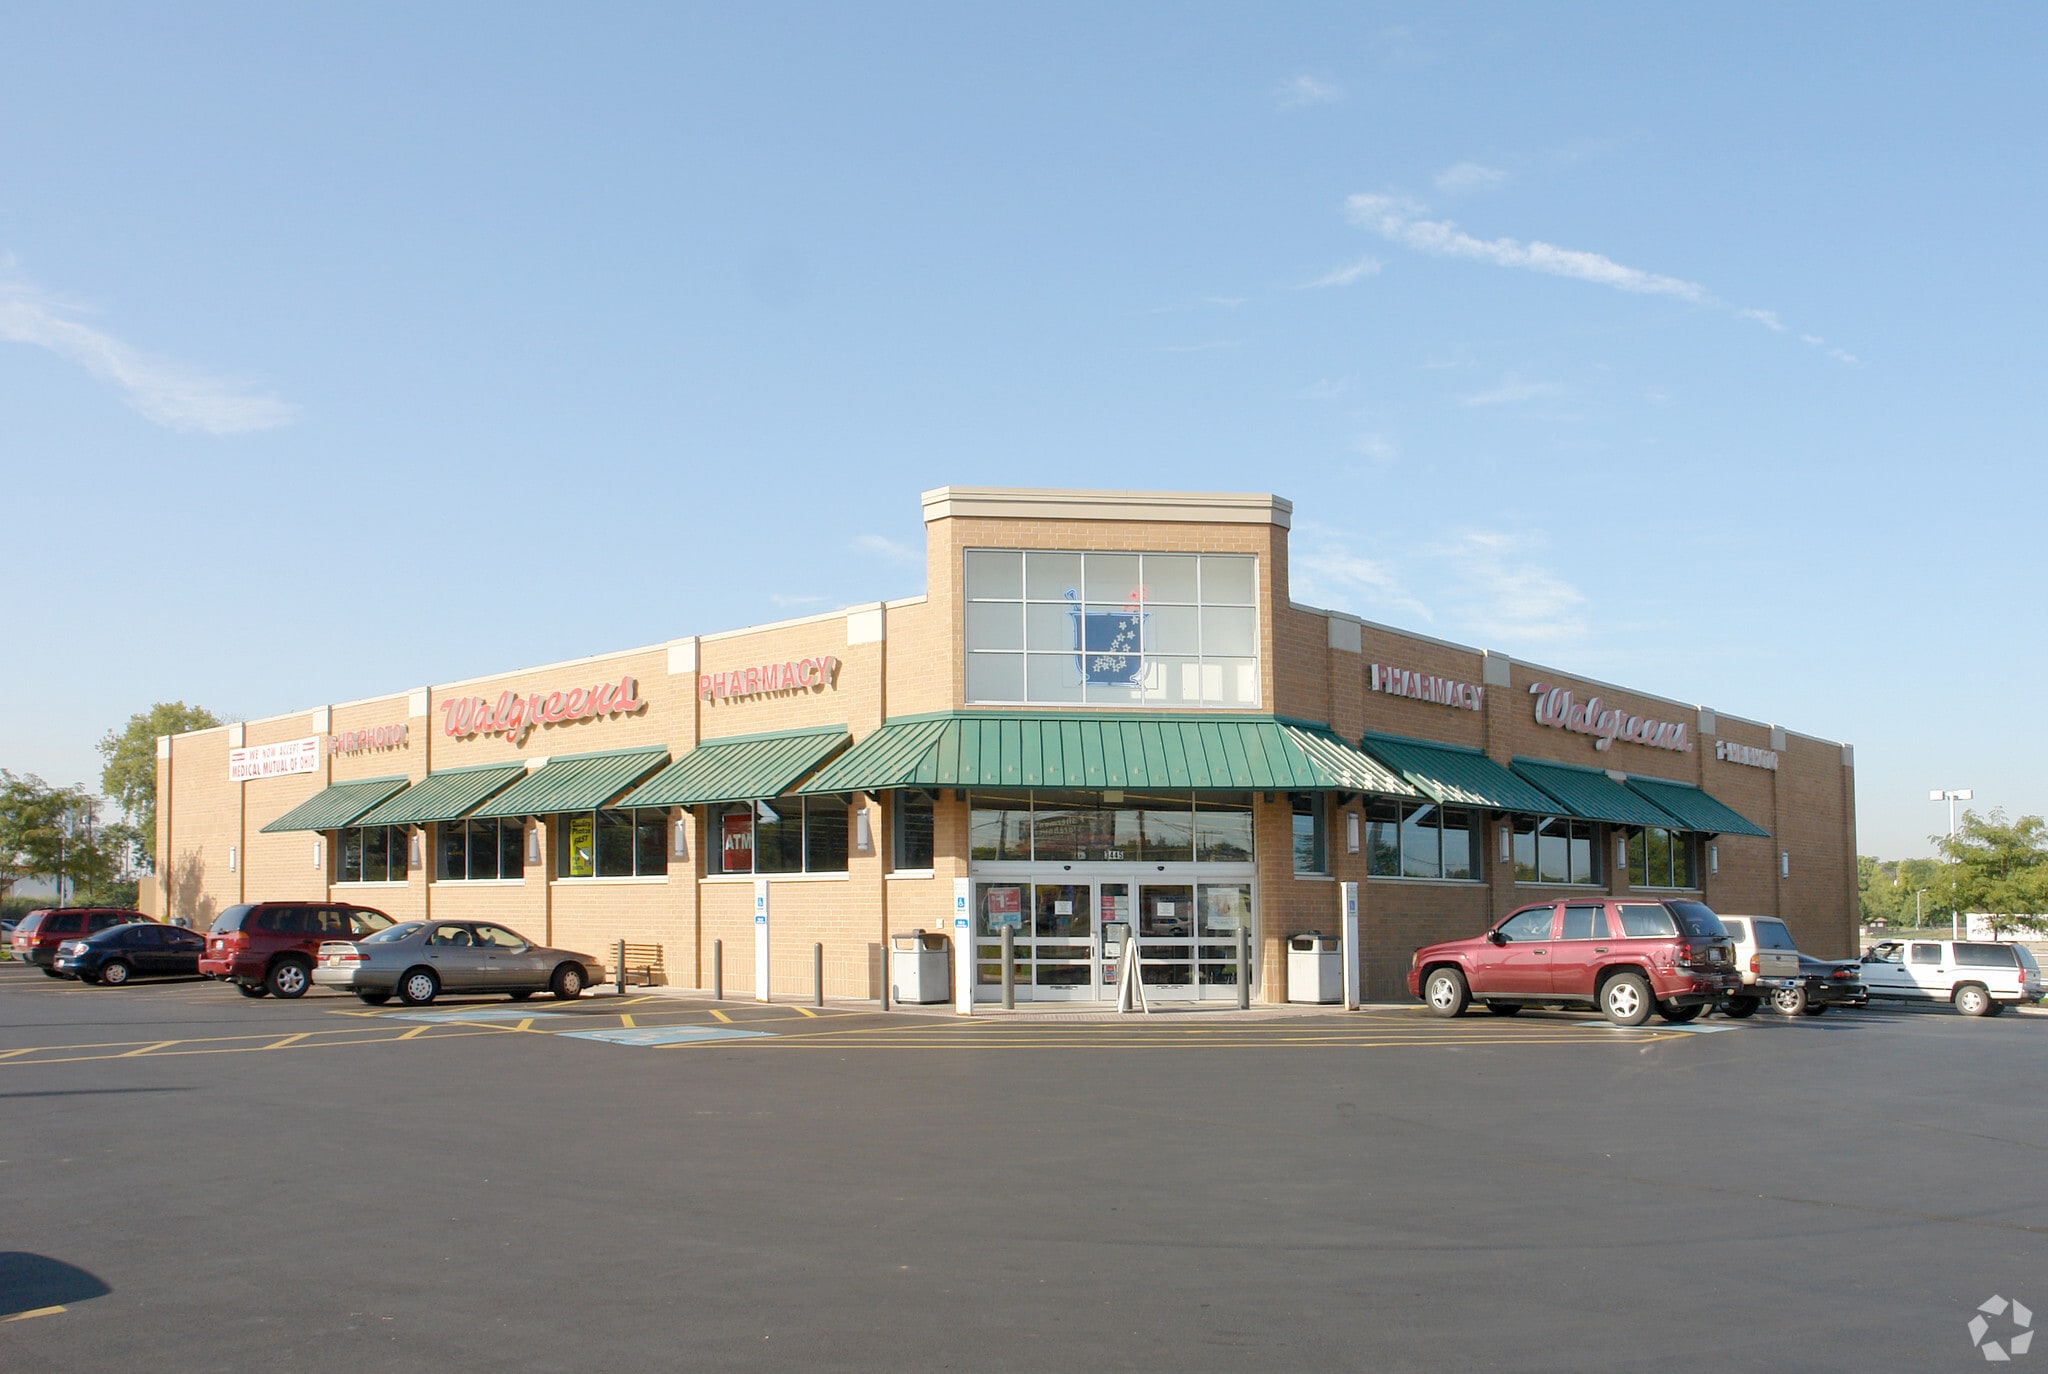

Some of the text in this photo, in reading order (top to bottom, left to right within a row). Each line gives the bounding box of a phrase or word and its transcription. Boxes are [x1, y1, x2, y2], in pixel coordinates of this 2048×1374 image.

[699, 656, 834, 701] PHARMACY
[1372, 664, 1485, 711] PHARMACY
[440, 676, 641, 744] Walgreens
[1529, 682, 1693, 752] Walgreens
[357, 724, 406, 750] PHOTO
[232, 755, 315, 778] MEDICAL MUTUAL OF OHIO
[725, 832, 752, 850] ATM
